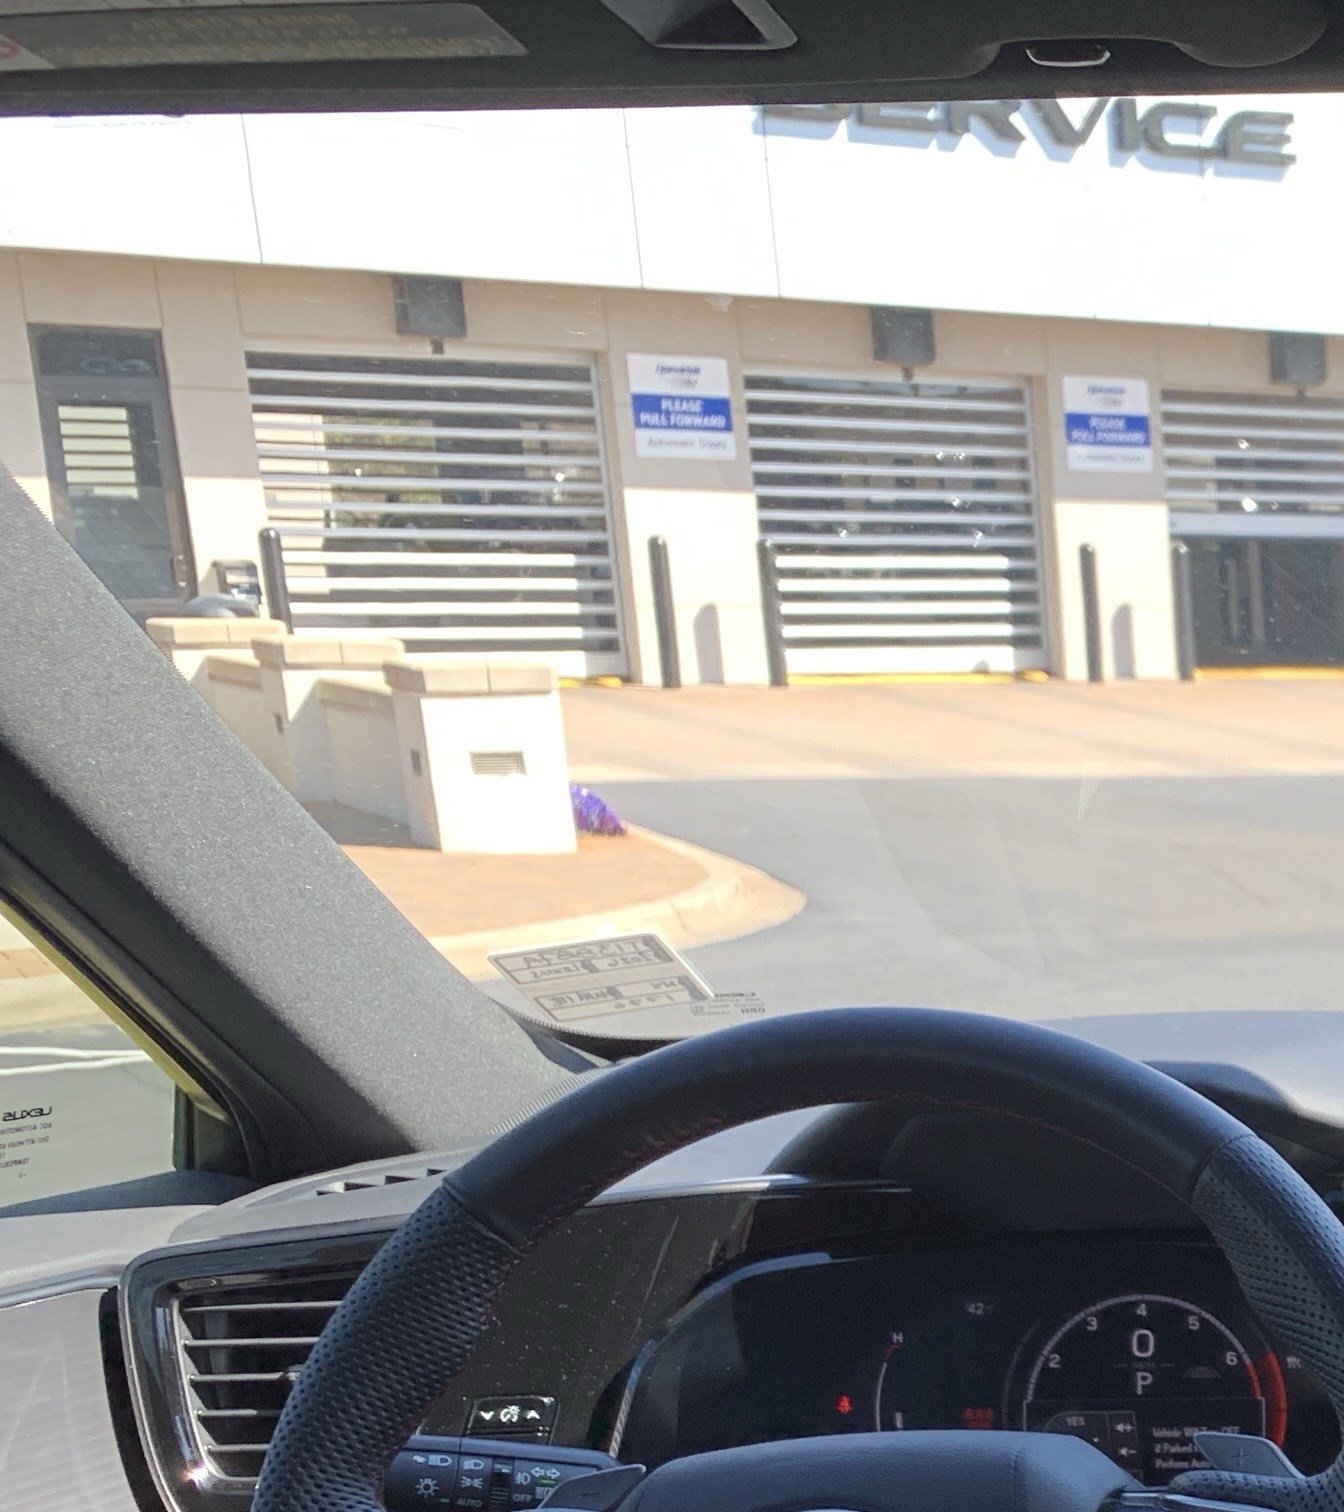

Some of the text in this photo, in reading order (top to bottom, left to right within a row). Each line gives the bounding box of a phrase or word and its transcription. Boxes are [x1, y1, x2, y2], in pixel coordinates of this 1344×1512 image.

[758, 96, 1298, 168] ERVICE
[1135, 1371, 1153, 1395] P
[455, 1496, 484, 1507] AUTO
